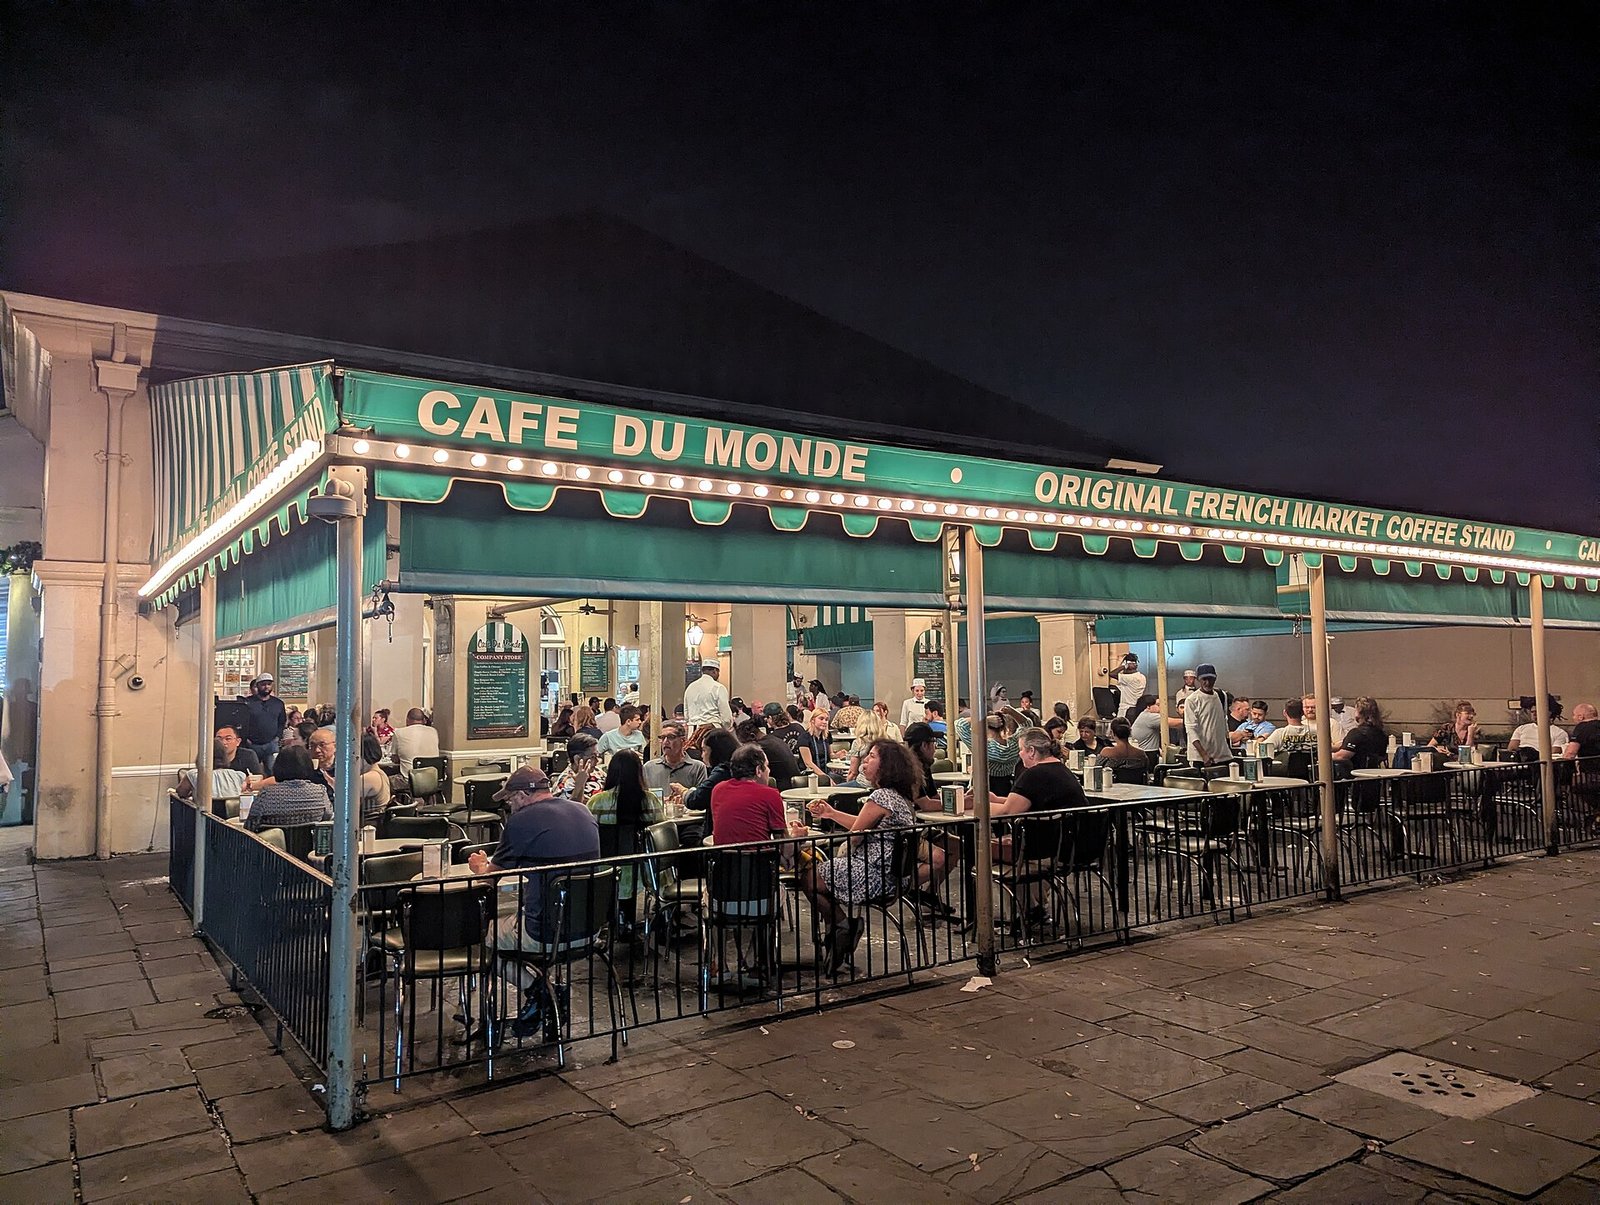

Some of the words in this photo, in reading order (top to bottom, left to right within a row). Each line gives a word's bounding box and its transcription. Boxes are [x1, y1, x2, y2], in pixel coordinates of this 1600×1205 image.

[247, 440, 279, 491] COFFEE
[283, 397, 326, 455] STAND
[417, 389, 580, 450] CAFE
[612, 414, 686, 461] DU
[704, 426, 869, 483] MONDE
[1034, 471, 1178, 516] ORIGINAL
[1185, 491, 1289, 527] FRENCH
[1298, 501, 1384, 539] MARKET
[1386, 515, 1458, 546] COFFEE
[1459, 523, 1516, 553] STAND
